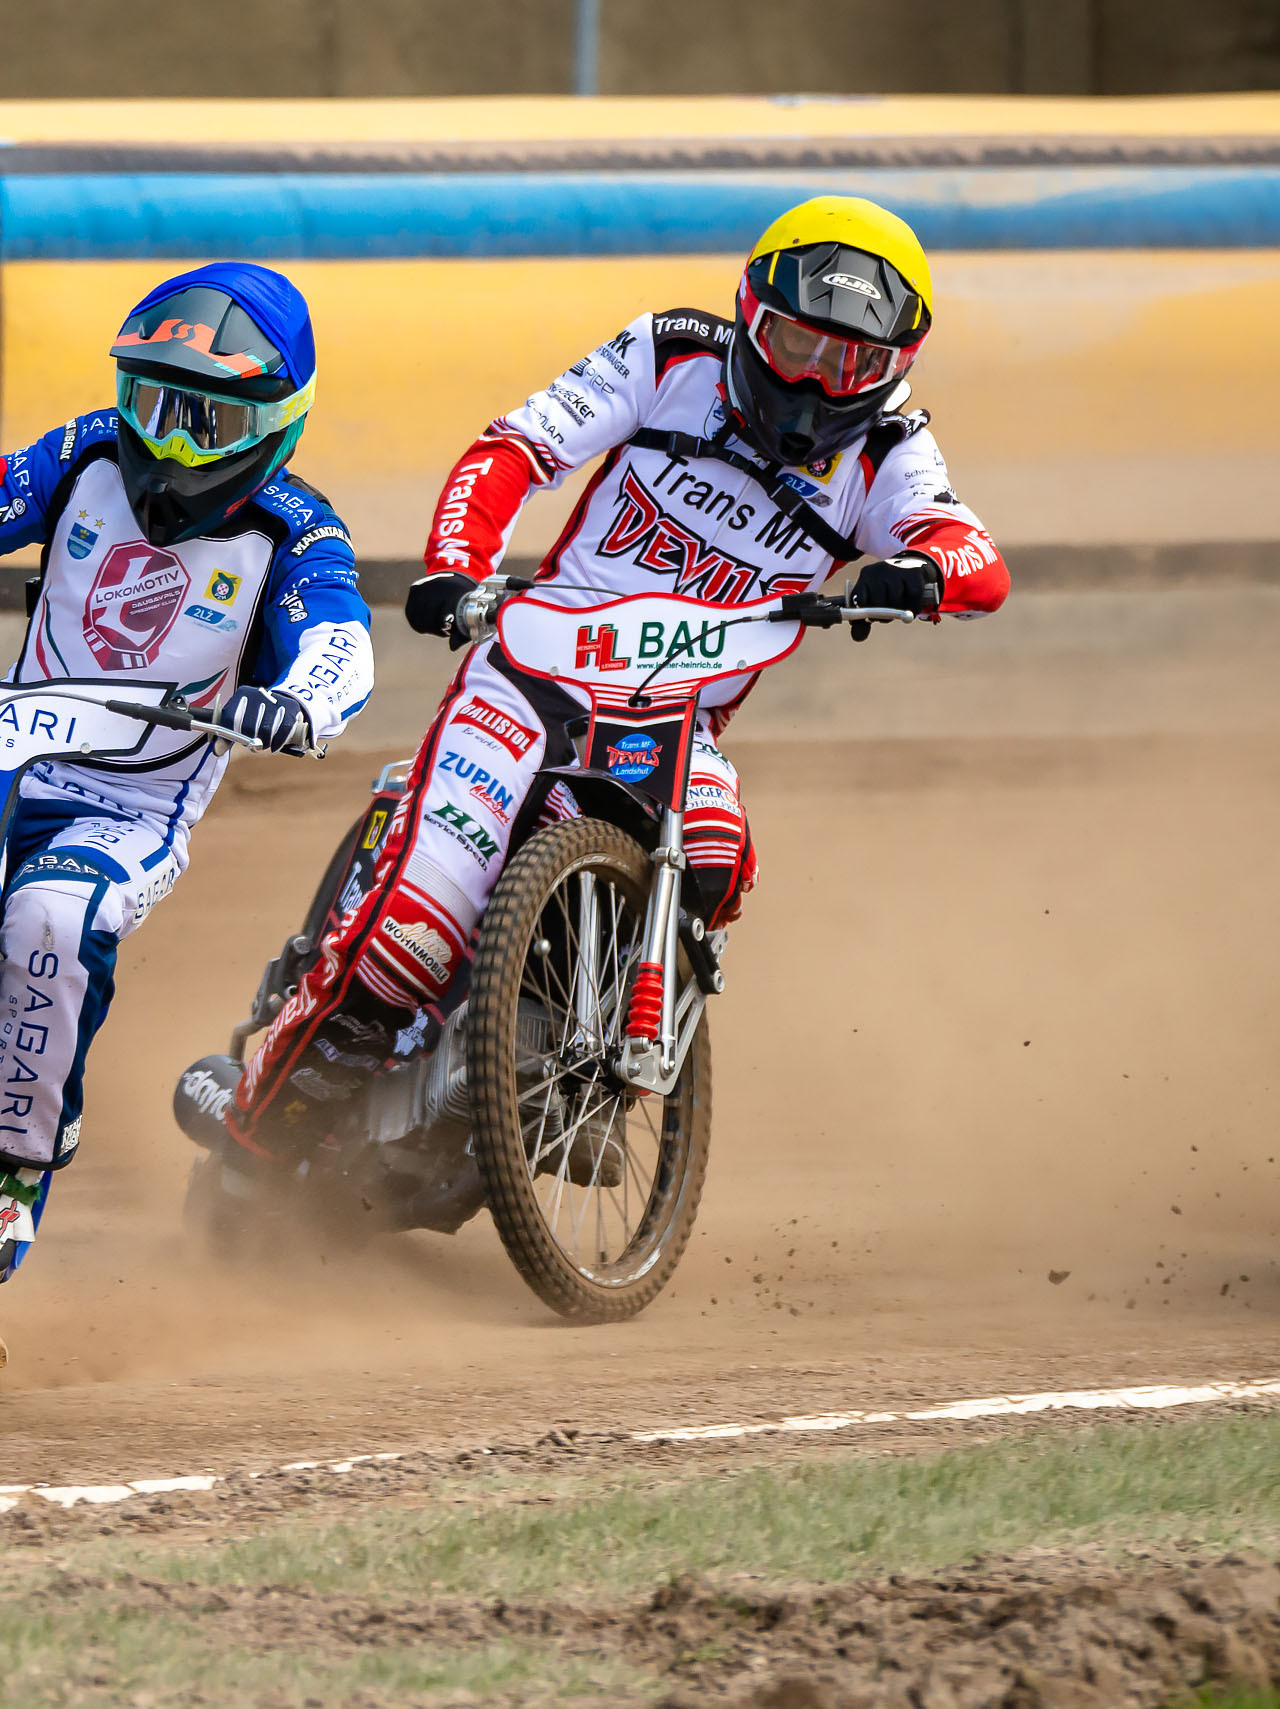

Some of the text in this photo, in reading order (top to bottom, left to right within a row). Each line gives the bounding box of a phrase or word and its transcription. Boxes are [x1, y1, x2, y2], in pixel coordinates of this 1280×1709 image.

[832, 275, 877, 295] HJC
[654, 316, 735, 345] Trans M
[272, 501, 302, 527] SPORTS
[435, 457, 494, 569] Trans MF
[652, 450, 814, 560] Trans MF
[929, 544, 984, 579] Trans
[95, 569, 180, 605] LOKOMOTIV
[574, 620, 727, 673] HL BAU
[287, 628, 358, 702] SAGARI
[459, 704, 532, 753] BALLISTOL
[606, 745, 663, 768] DEVILS
[615, 766, 649, 776] Landshut
[438, 751, 514, 811] ZUPIN
[687, 786, 724, 800] NGER
[423, 813, 456, 839] Service
[431, 800, 502, 864] HM
[383, 918, 449, 983] WOHNMOBILE
